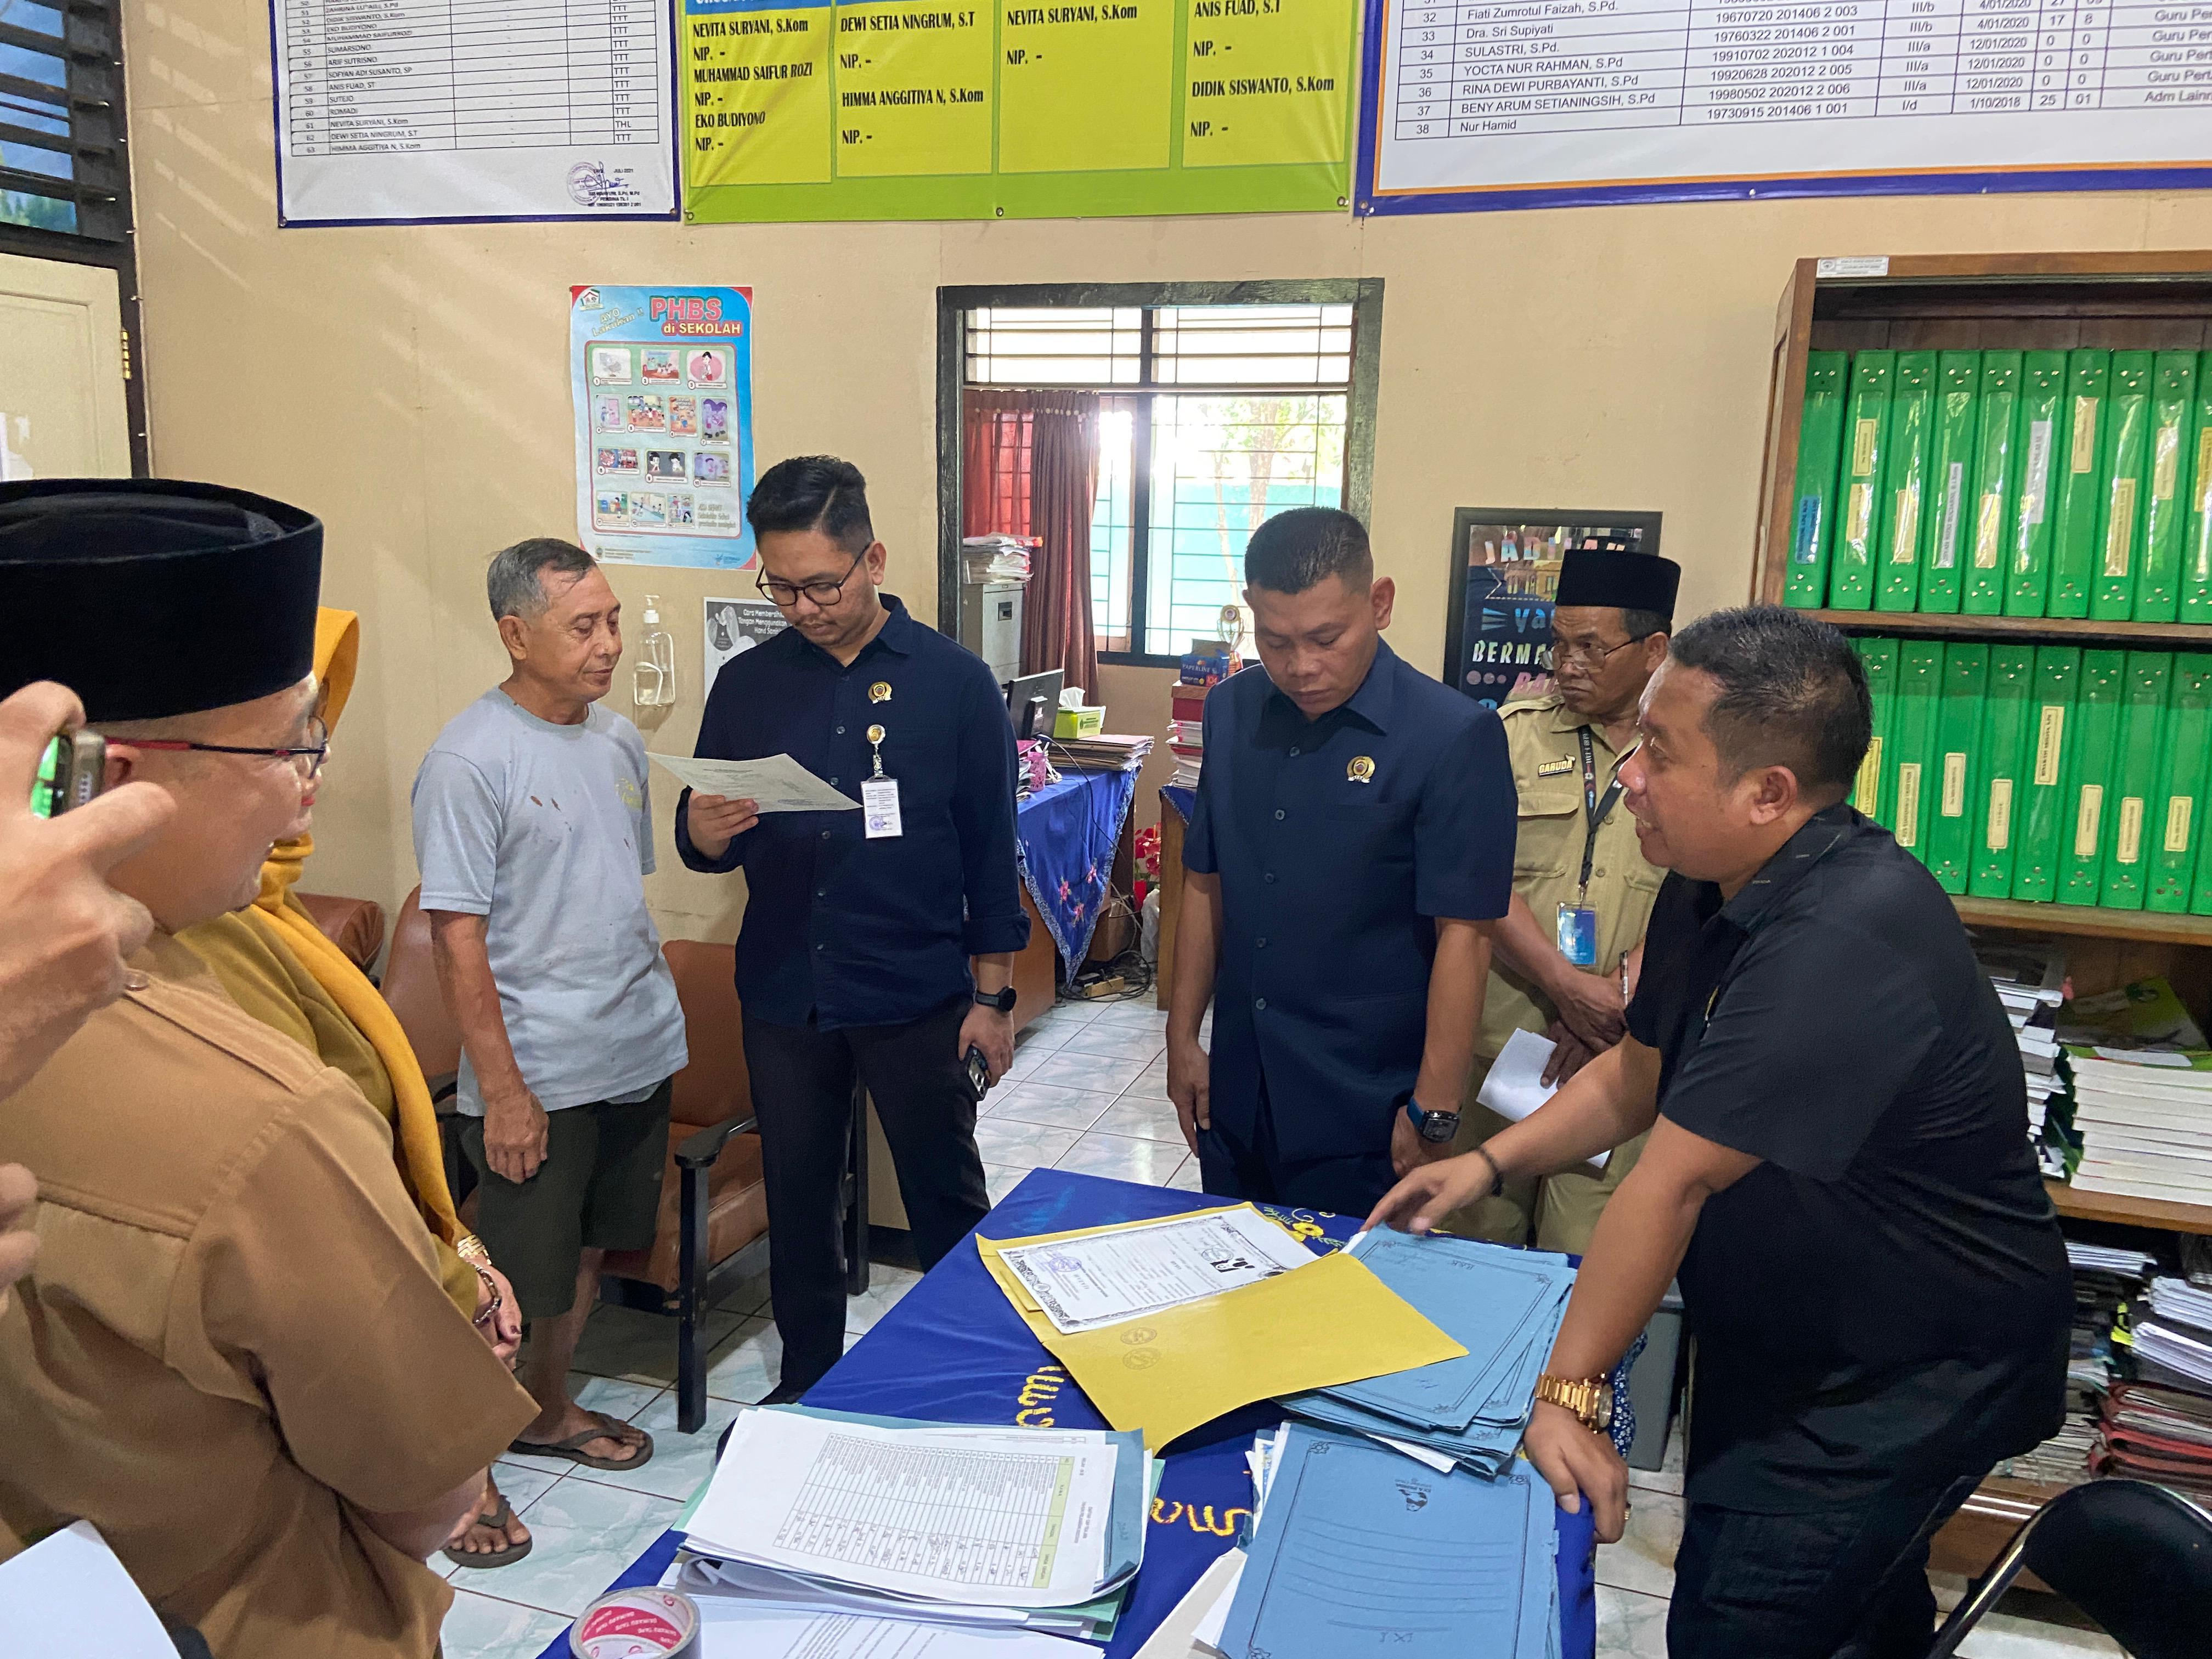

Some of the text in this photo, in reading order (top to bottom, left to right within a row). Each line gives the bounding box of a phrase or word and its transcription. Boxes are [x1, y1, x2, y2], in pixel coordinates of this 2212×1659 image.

[1195, 2, 1221, 17] ANIS
[1226, 0, 1258, 17] FUAD,
[1468, 1, 1618, 20] Fiati Zumrotul Faizah, S.Pd.
[1912, 2, 1934, 13] III/b
[1007, 5, 1137, 25] NEVITA SURYANI, S.Kom
[1423, 13, 1436, 22] 32
[1716, 7, 1857, 24] 19670720 201406 2 003
[2050, 15, 2064, 26] 17
[2155, 10, 2187, 22] Guru
[693, 18, 808, 37] NEVITA SURYANI, S.Kom
[841, 12, 974, 32] DEWI SETIA NINGRUM, S.T
[1910, 21, 1932, 32] III/b
[1977, 17, 2029, 28] 4/01/2020
[1422, 31, 1435, 41] 33
[1467, 24, 1553, 39] Dra. Sri Supiyati
[1714, 26, 1855, 42] 19760322 201406 2 001
[2152, 30, 2185, 42] Guru
[1194, 41, 1216, 57] NIP.
[1465, 42, 1559, 58] SULASTRI, S.Pd.
[1908, 42, 1930, 52] III/a
[1970, 38, 2027, 49] 12/01/2020
[693, 47, 713, 60] NIP.
[1007, 50, 1028, 65] NIP.
[1421, 50, 1433, 60] 34
[1713, 45, 1853, 61] 19910702 202012 1 004
[2151, 50, 2182, 63] Guru
[840, 54, 862, 68] NIP.
[1464, 57, 1622, 76] YOCTA NUR RAHMAN, S.Pd
[1906, 61, 1928, 72] III/a
[1968, 58, 2024, 69] 12/01/2020
[694, 62, 812, 82] MUHAMMAD SAIFUR ROZI
[1420, 68, 1432, 78] 35
[1711, 64, 1852, 81] 19920628 202012 2 005
[2148, 70, 2180, 82] Guru
[1192, 77, 1333, 97] DIDIK SISWANTO, S.Kom
[1463, 75, 1638, 95] RINA DEWI PURBAYANTI, S.Pd
[1905, 81, 1926, 92] III/a
[1966, 77, 2022, 89] 12/01/2020
[842, 89, 983, 106] HIMMA ANGGITIYA N, S.Kom
[1419, 87, 1431, 97] 36
[1709, 83, 1850, 100] 19980502 202012 2 006
[2145, 91, 2175, 103] Adm
[695, 92, 714, 106] NIP.
[1462, 93, 1655, 114] BENY ARUM SETIANINGSIH, S.Pd
[1903, 100, 1917, 110] I/d
[1970, 97, 2021, 109] 1/10/2018
[2040, 95, 2056, 105] 25
[2076, 94, 2091, 104] 01
[1418, 105, 1430, 116] 37
[1707, 103, 1847, 119] 19730915 201406 1 001
[696, 111, 765, 128] EKO BUDIYONO
[1460, 119, 1516, 132] Nur Hamid
[1191, 121, 1213, 137] NIP.
[1417, 124, 1429, 134] 38
[842, 130, 862, 144] NIP.
[696, 137, 714, 151] NIP.
[651, 297, 722, 321] PHBS
[664, 323, 740, 334] di SEKOLAH
[1539, 760, 1573, 774] GARUDA
